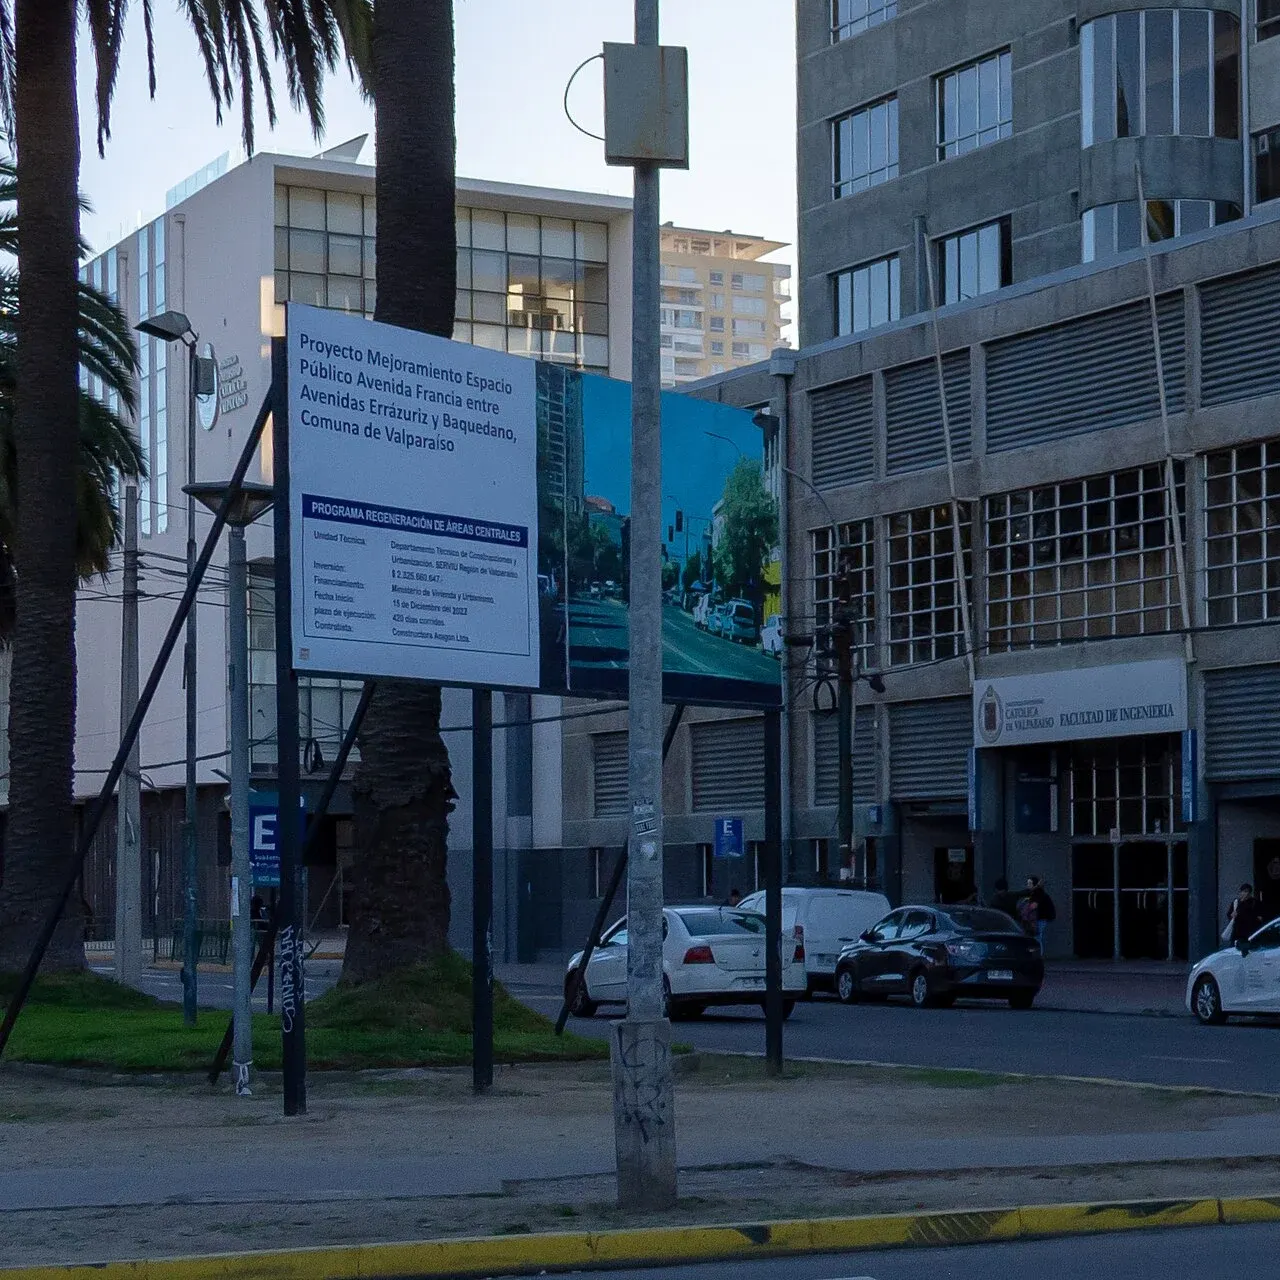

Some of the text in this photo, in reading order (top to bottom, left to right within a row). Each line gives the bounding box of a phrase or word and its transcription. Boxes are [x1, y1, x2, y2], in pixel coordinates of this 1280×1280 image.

[300, 333, 512, 395] Proyecto Mejoramiento Espacio
[300, 359, 500, 415] Público Avenida Francia entre
[300, 384, 517, 443] Avenidas Errázuriz y Baquedano,
[301, 410, 454, 452] Comuna de Valparaíso
[311, 501, 520, 542] PROGRAMA REGENERACIÓN DE ÁREAS CENTRALES
[461, 549, 468, 558] de
[435, 560, 459, 571] SERVIU
[480, 566, 488, 575] de
[314, 590, 334, 602] Fecha
[422, 588, 430, 597] de
[333, 608, 341, 616] de
[401, 600, 409, 609] de
[410, 601, 441, 612] Diciembre
[1060, 710, 1104, 726] FACULTAD
[1106, 708, 1118, 722] DE
[253, 814, 277, 850] E
[723, 820, 733, 834] E
